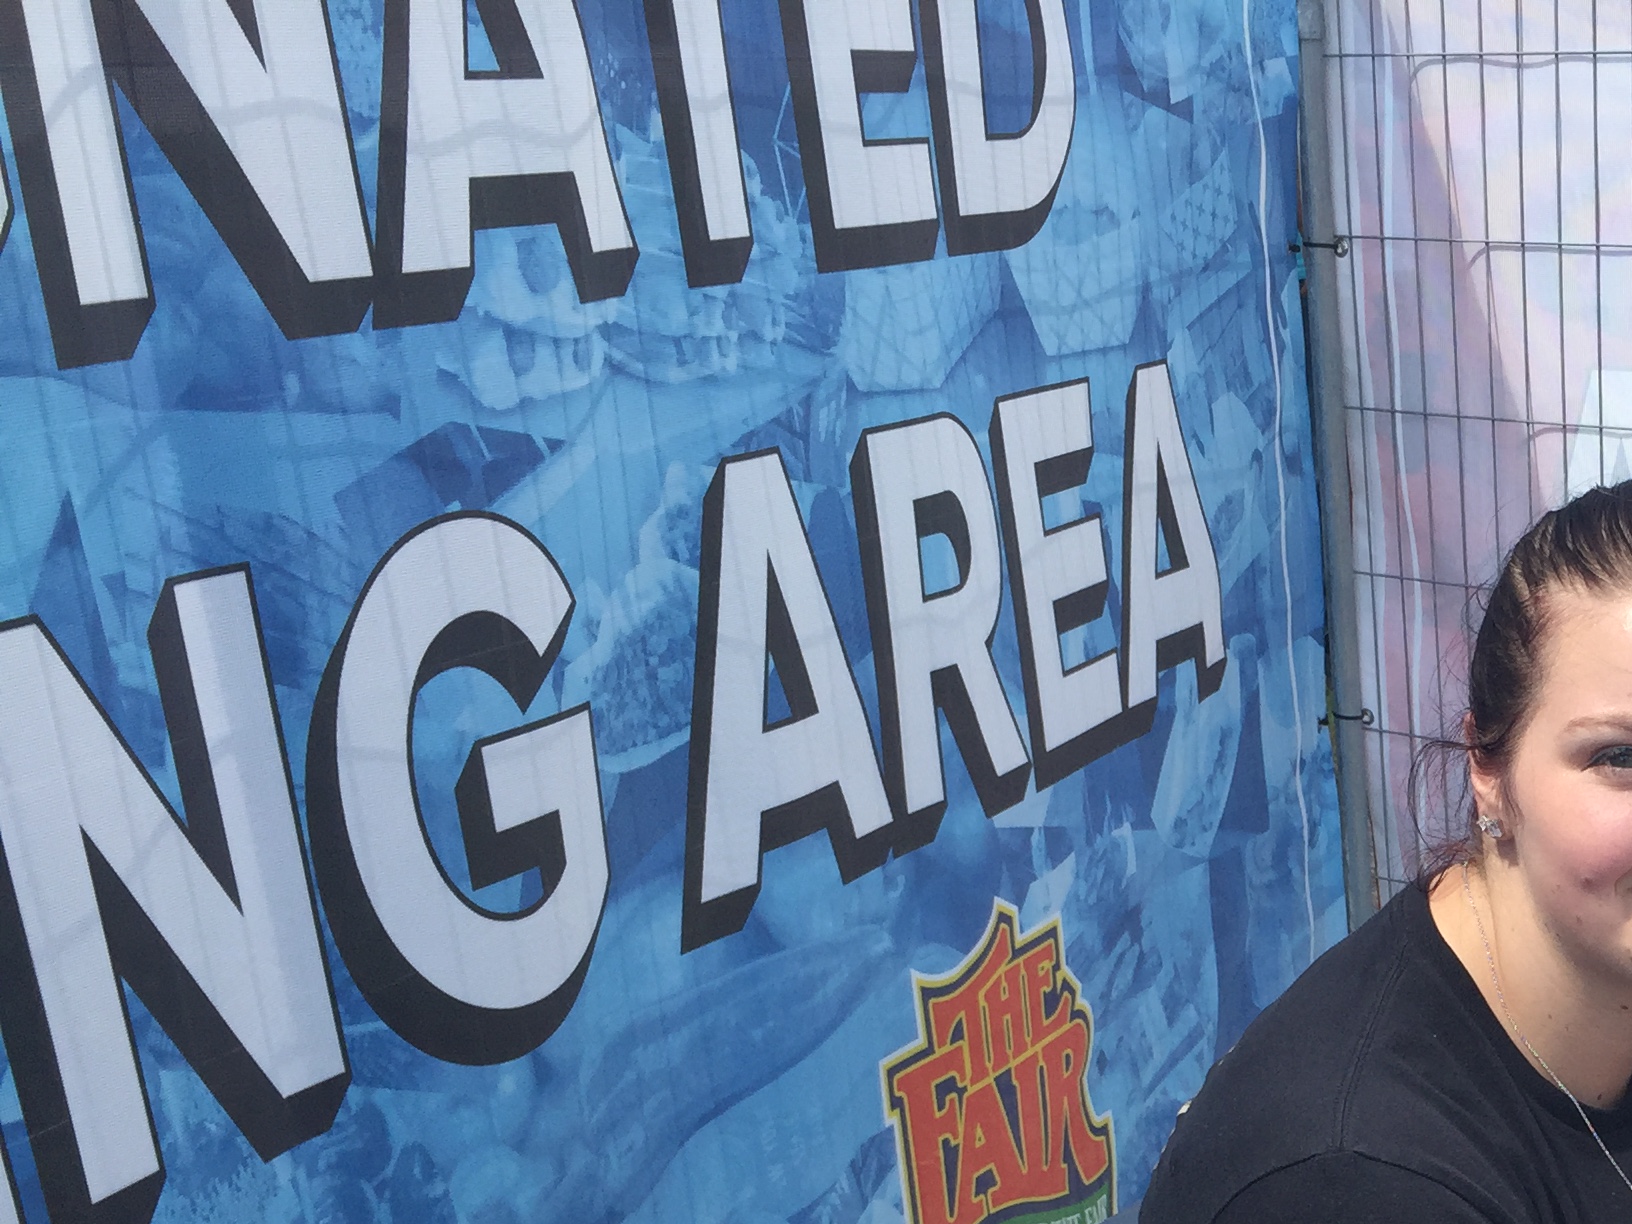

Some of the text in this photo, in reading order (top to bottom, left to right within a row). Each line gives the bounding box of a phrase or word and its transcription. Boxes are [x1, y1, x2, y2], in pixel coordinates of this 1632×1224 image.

[0, 0, 1076, 370] NATED
[682, 358, 1226, 955] AREA
[929, 921, 1072, 1088] THE
